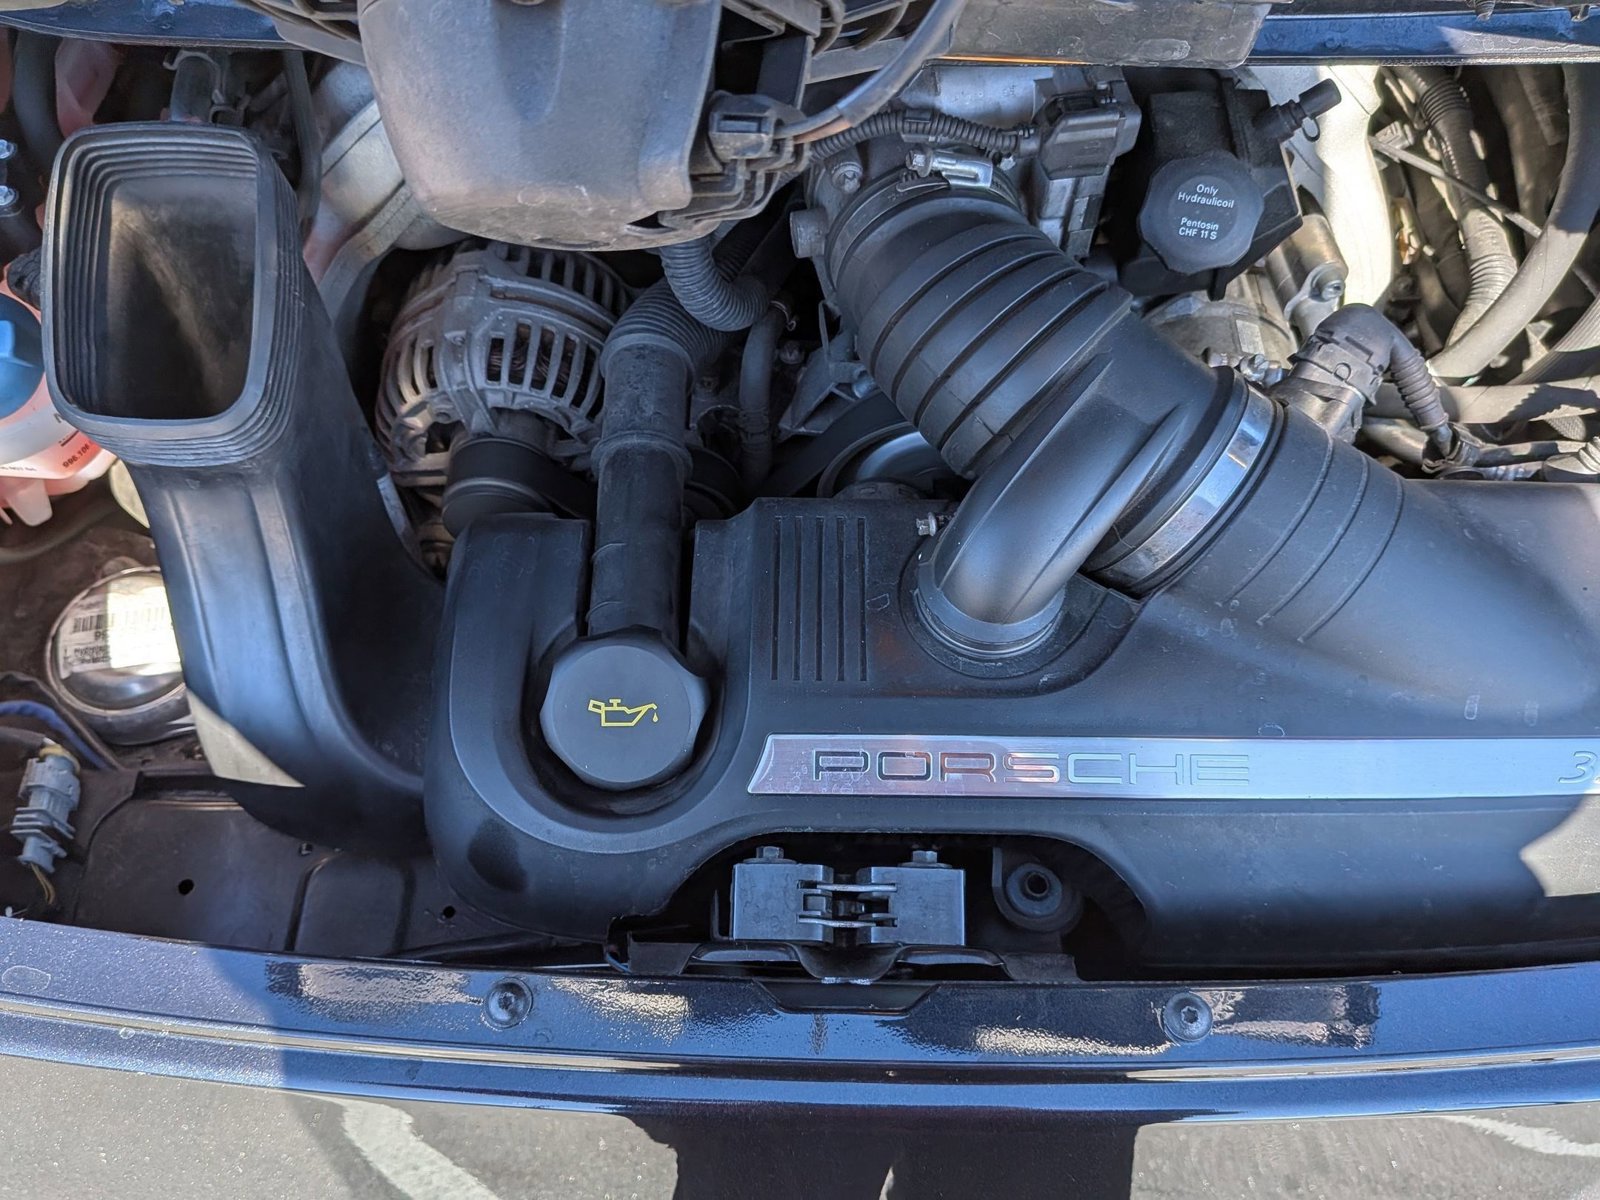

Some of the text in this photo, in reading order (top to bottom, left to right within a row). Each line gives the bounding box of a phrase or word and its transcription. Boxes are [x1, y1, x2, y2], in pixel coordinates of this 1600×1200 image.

[1196, 184, 1219, 197] Only
[1177, 191, 1235, 209] Hydraulicoil
[1180, 217, 1219, 231] Pentosin
[1178, 226, 1218, 240] CHF 11 S
[812, 750, 1249, 786] PORSCHE
